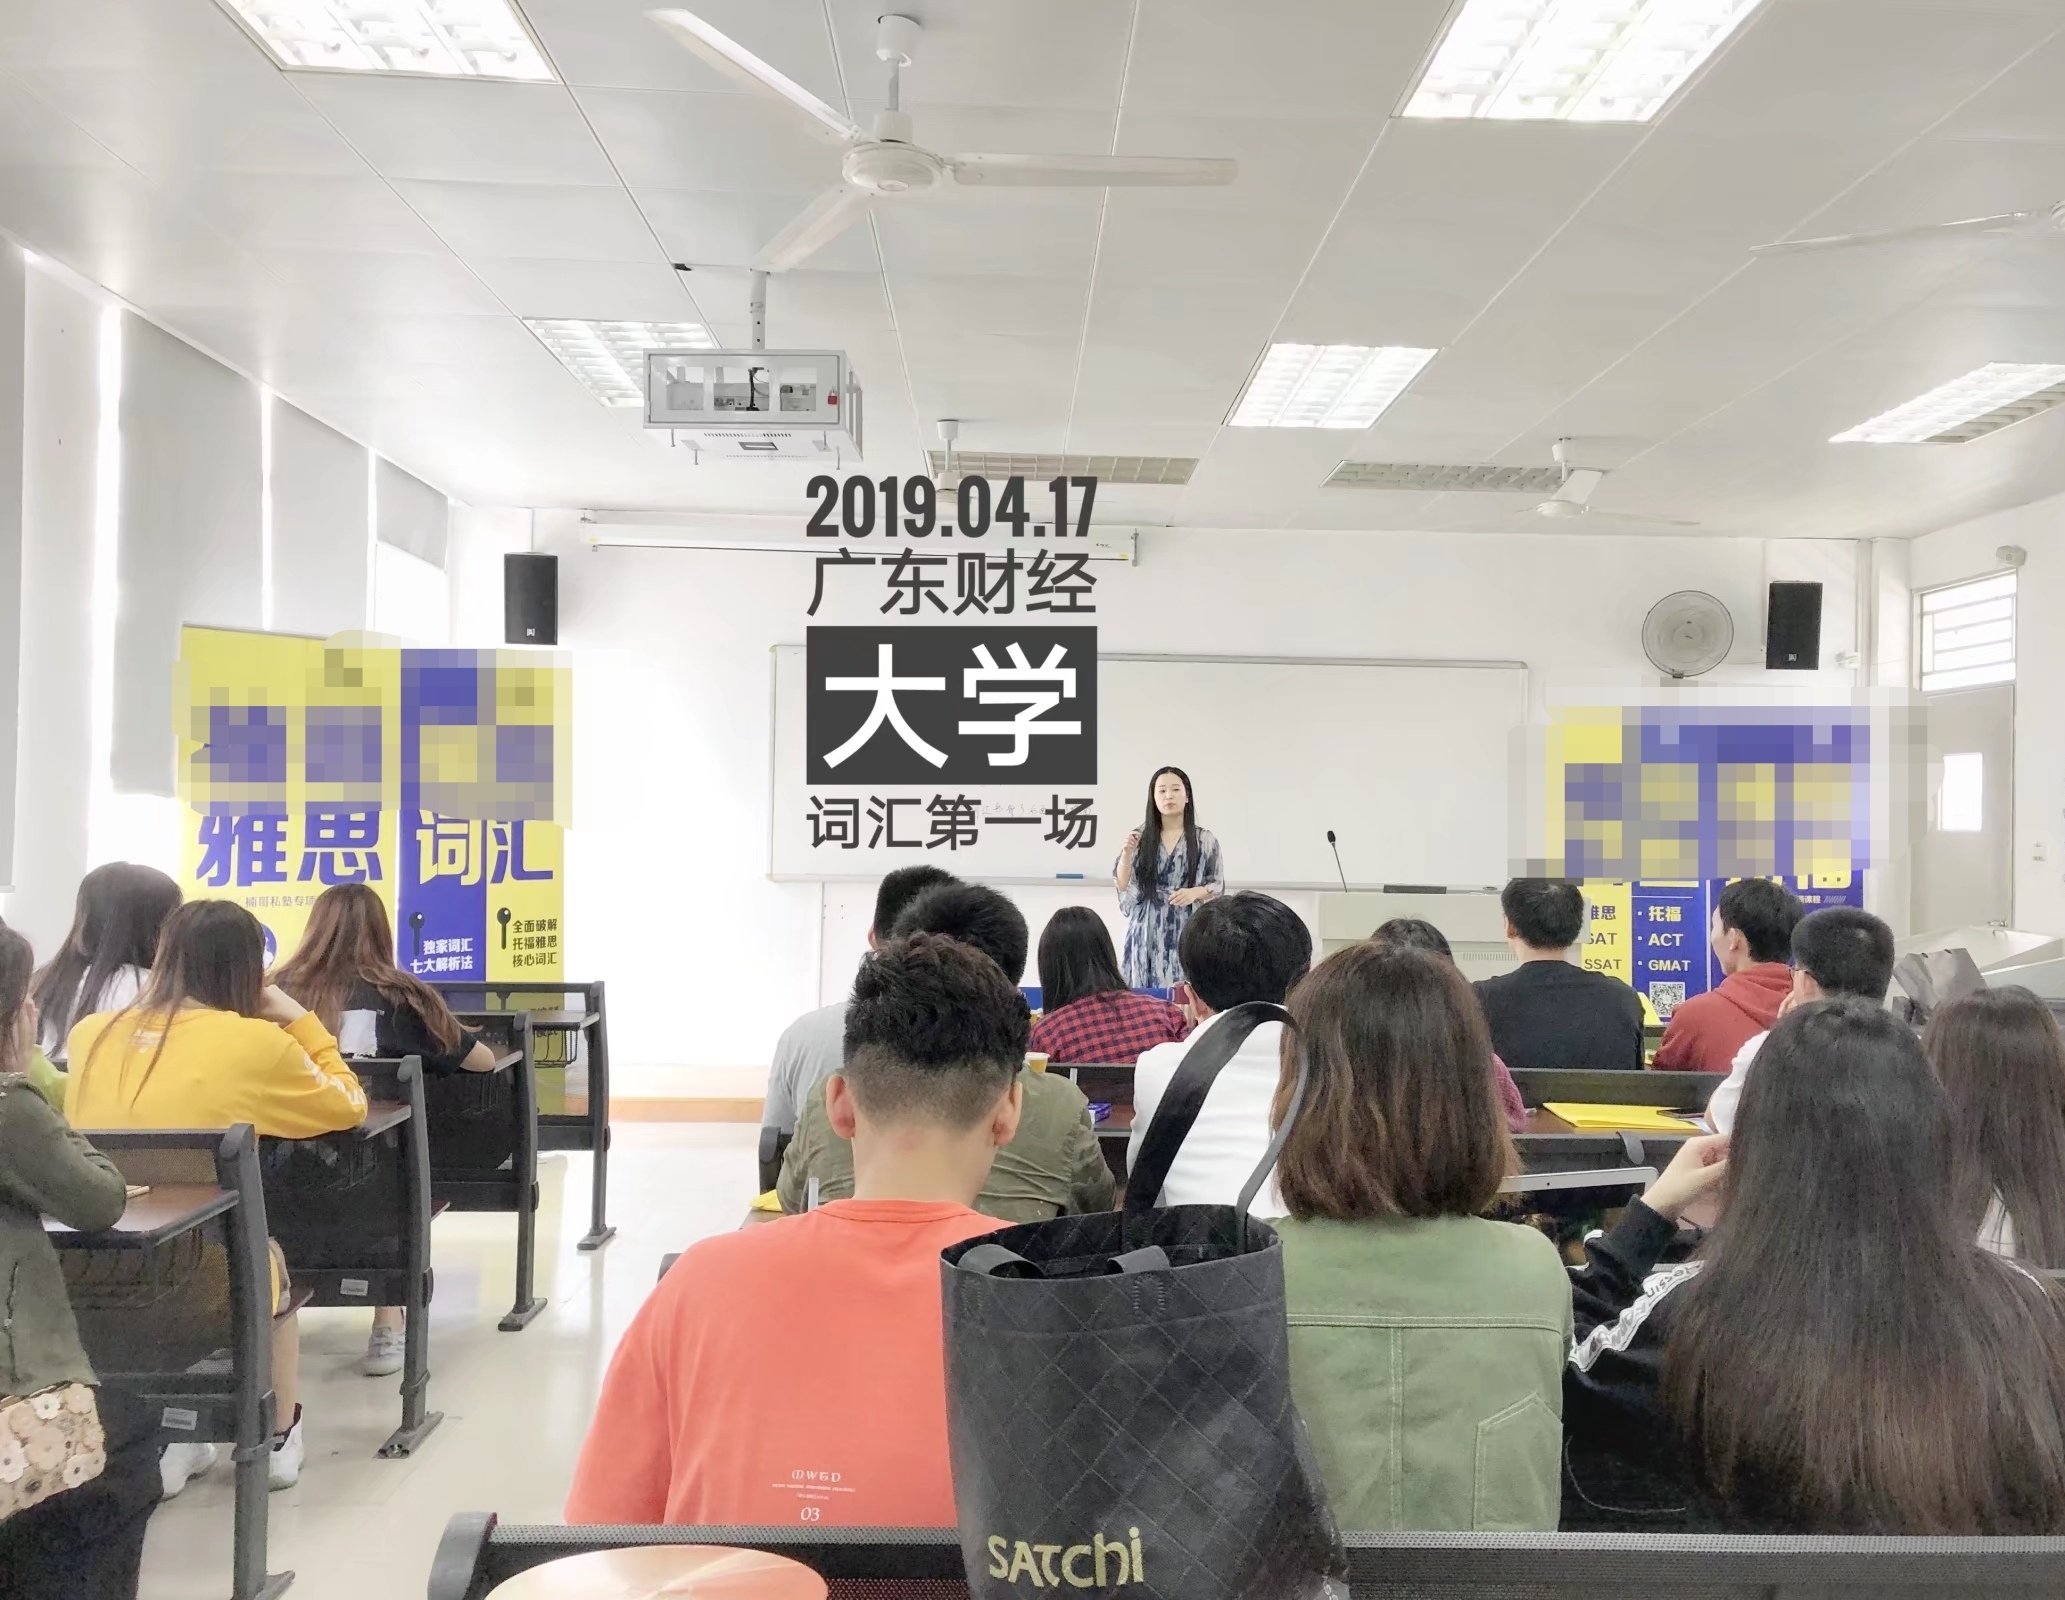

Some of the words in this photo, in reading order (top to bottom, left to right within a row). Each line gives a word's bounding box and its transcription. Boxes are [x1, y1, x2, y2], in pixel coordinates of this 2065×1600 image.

[1648, 905, 1682, 922] 托福
[512, 918, 557, 933] 全面破解
[423, 938, 473, 956] 独家词汇
[512, 935, 557, 951] 托福雅思
[1648, 933, 1683, 946] ACT
[410, 956, 473, 974] 七大解析法
[512, 952, 557, 968] 核心词汇
[1584, 958, 1622, 970] SSAT
[1648, 959, 1691, 972] GMAT
[800, 1506, 820, 1522] 03
